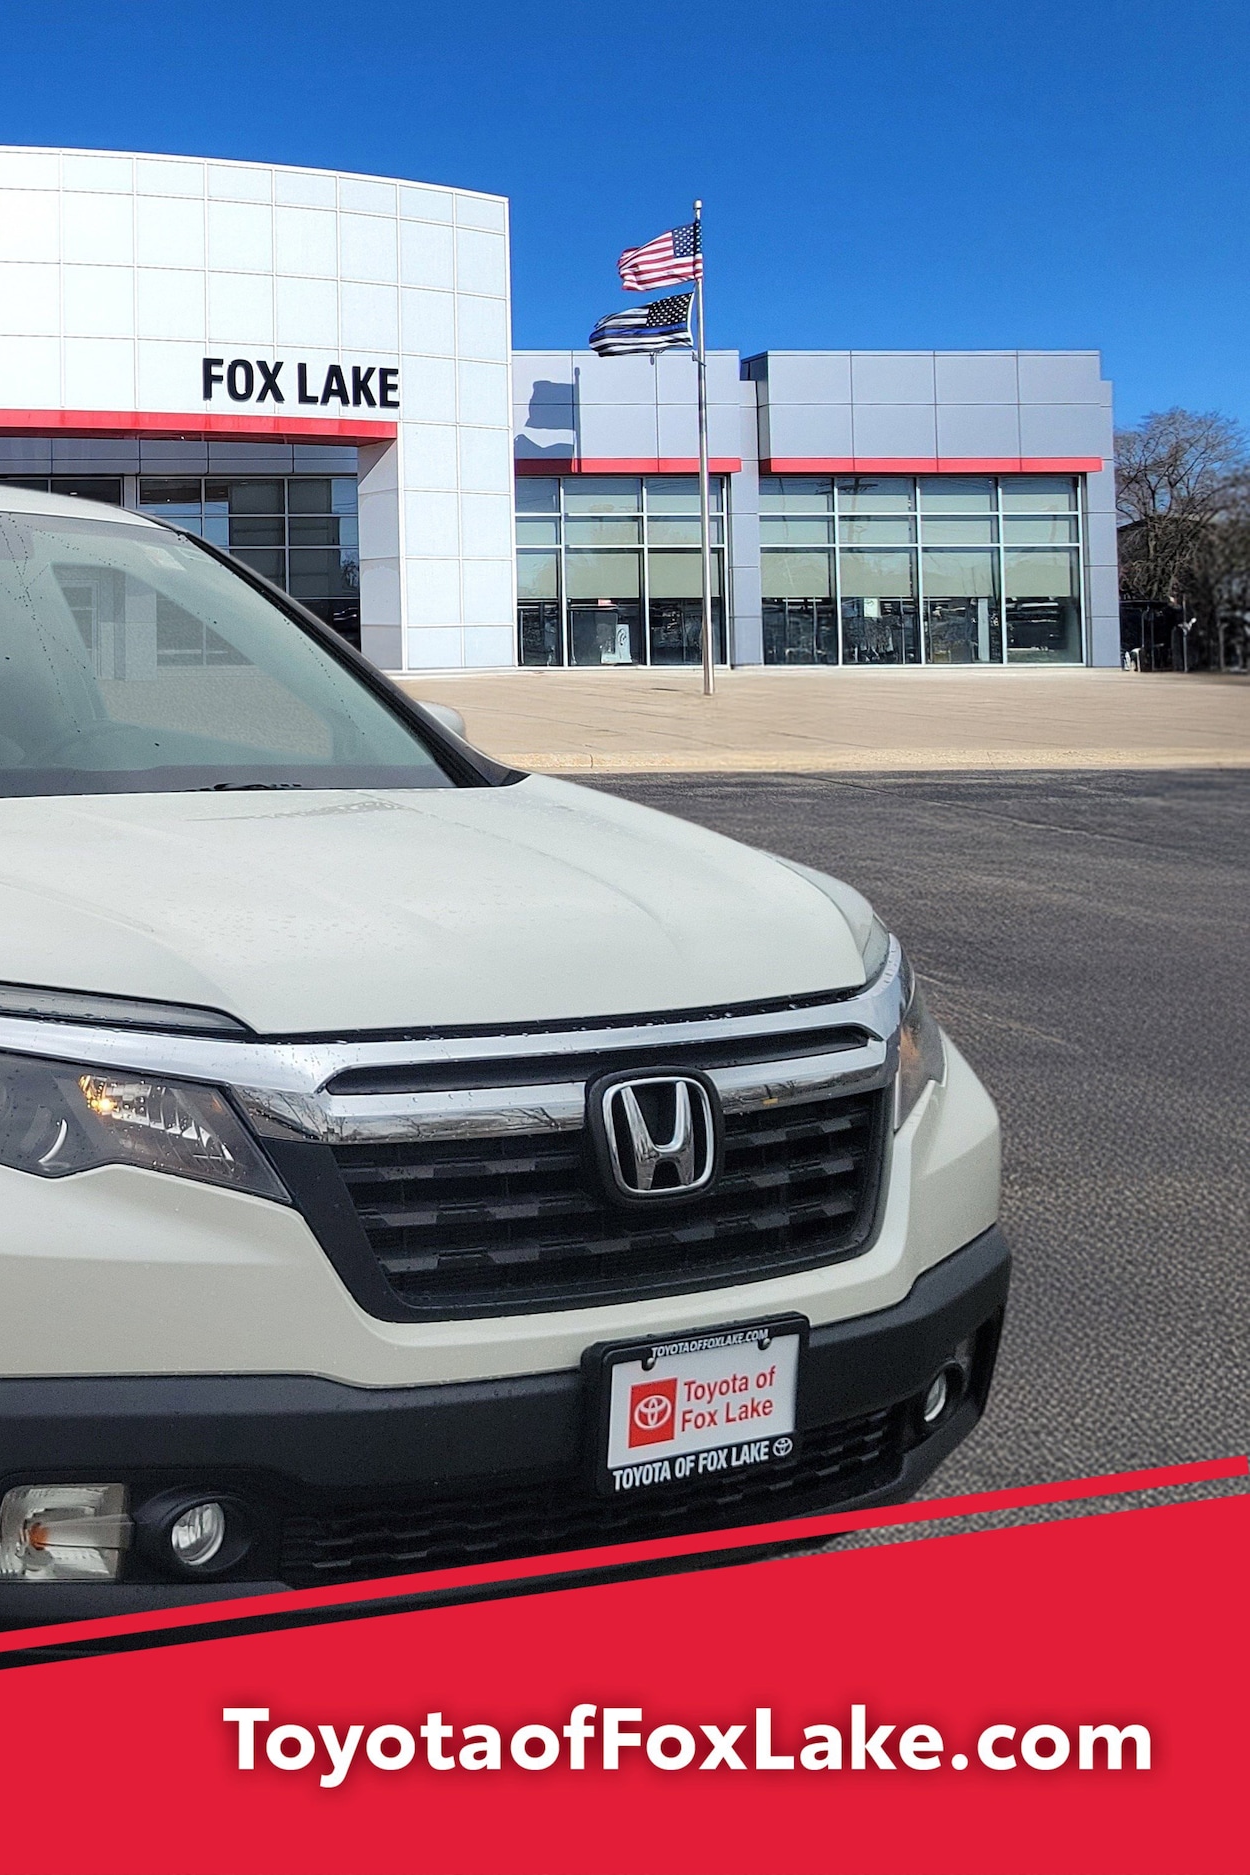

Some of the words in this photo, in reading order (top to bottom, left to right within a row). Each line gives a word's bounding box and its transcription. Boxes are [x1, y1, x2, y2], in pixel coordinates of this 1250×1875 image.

[203, 358, 285, 403] FOX
[298, 362, 400, 408] LAKE
[651, 1329, 769, 1358] TOYOTAOFFOXLAKE.COM
[684, 1374, 749, 1404] Toyota
[755, 1366, 776, 1389] of
[681, 1408, 718, 1432] Fox
[725, 1397, 774, 1424] Lake
[613, 1460, 671, 1492] TOYOTA
[675, 1455, 695, 1479] OF
[698, 1448, 729, 1474] FOX
[731, 1441, 770, 1467] LAKE
